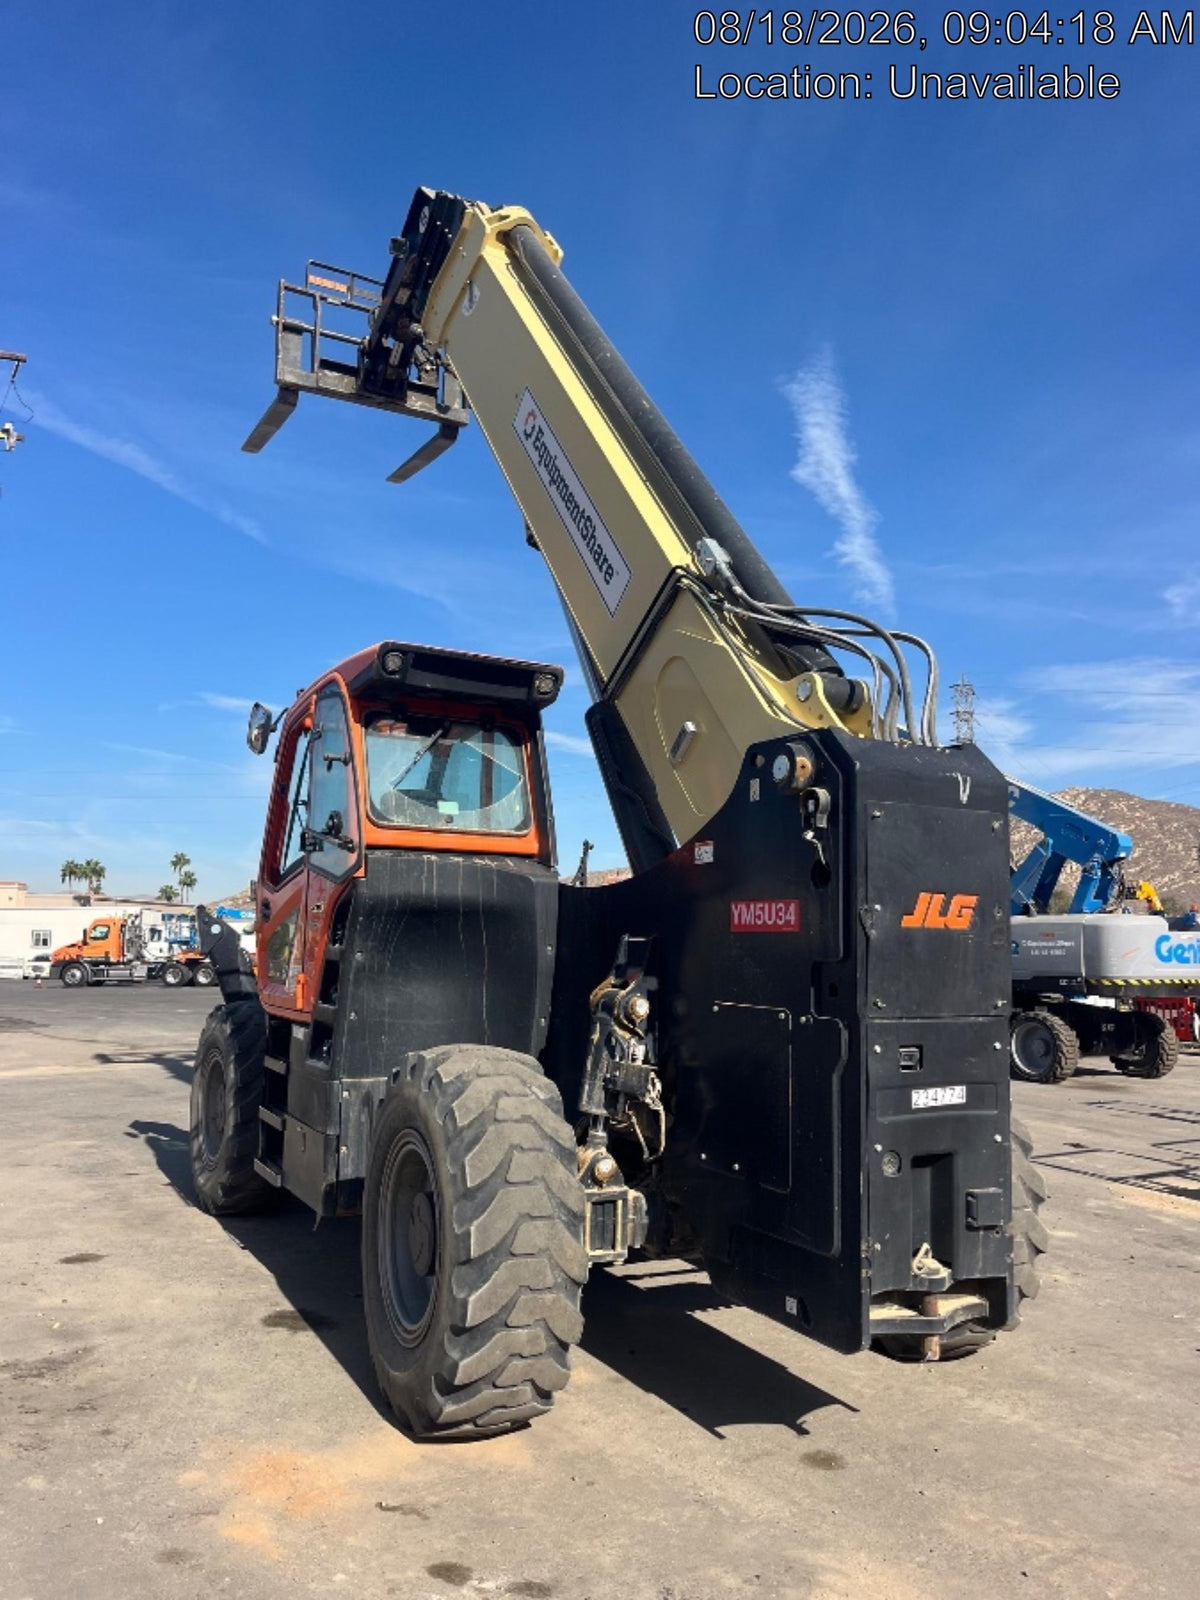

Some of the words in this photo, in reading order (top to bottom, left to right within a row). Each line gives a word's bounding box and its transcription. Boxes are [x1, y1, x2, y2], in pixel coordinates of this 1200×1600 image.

[532, 424, 616, 586] EquipmentShare
[731, 902, 795, 926] YM5U34
[901, 891, 980, 930] JLG
